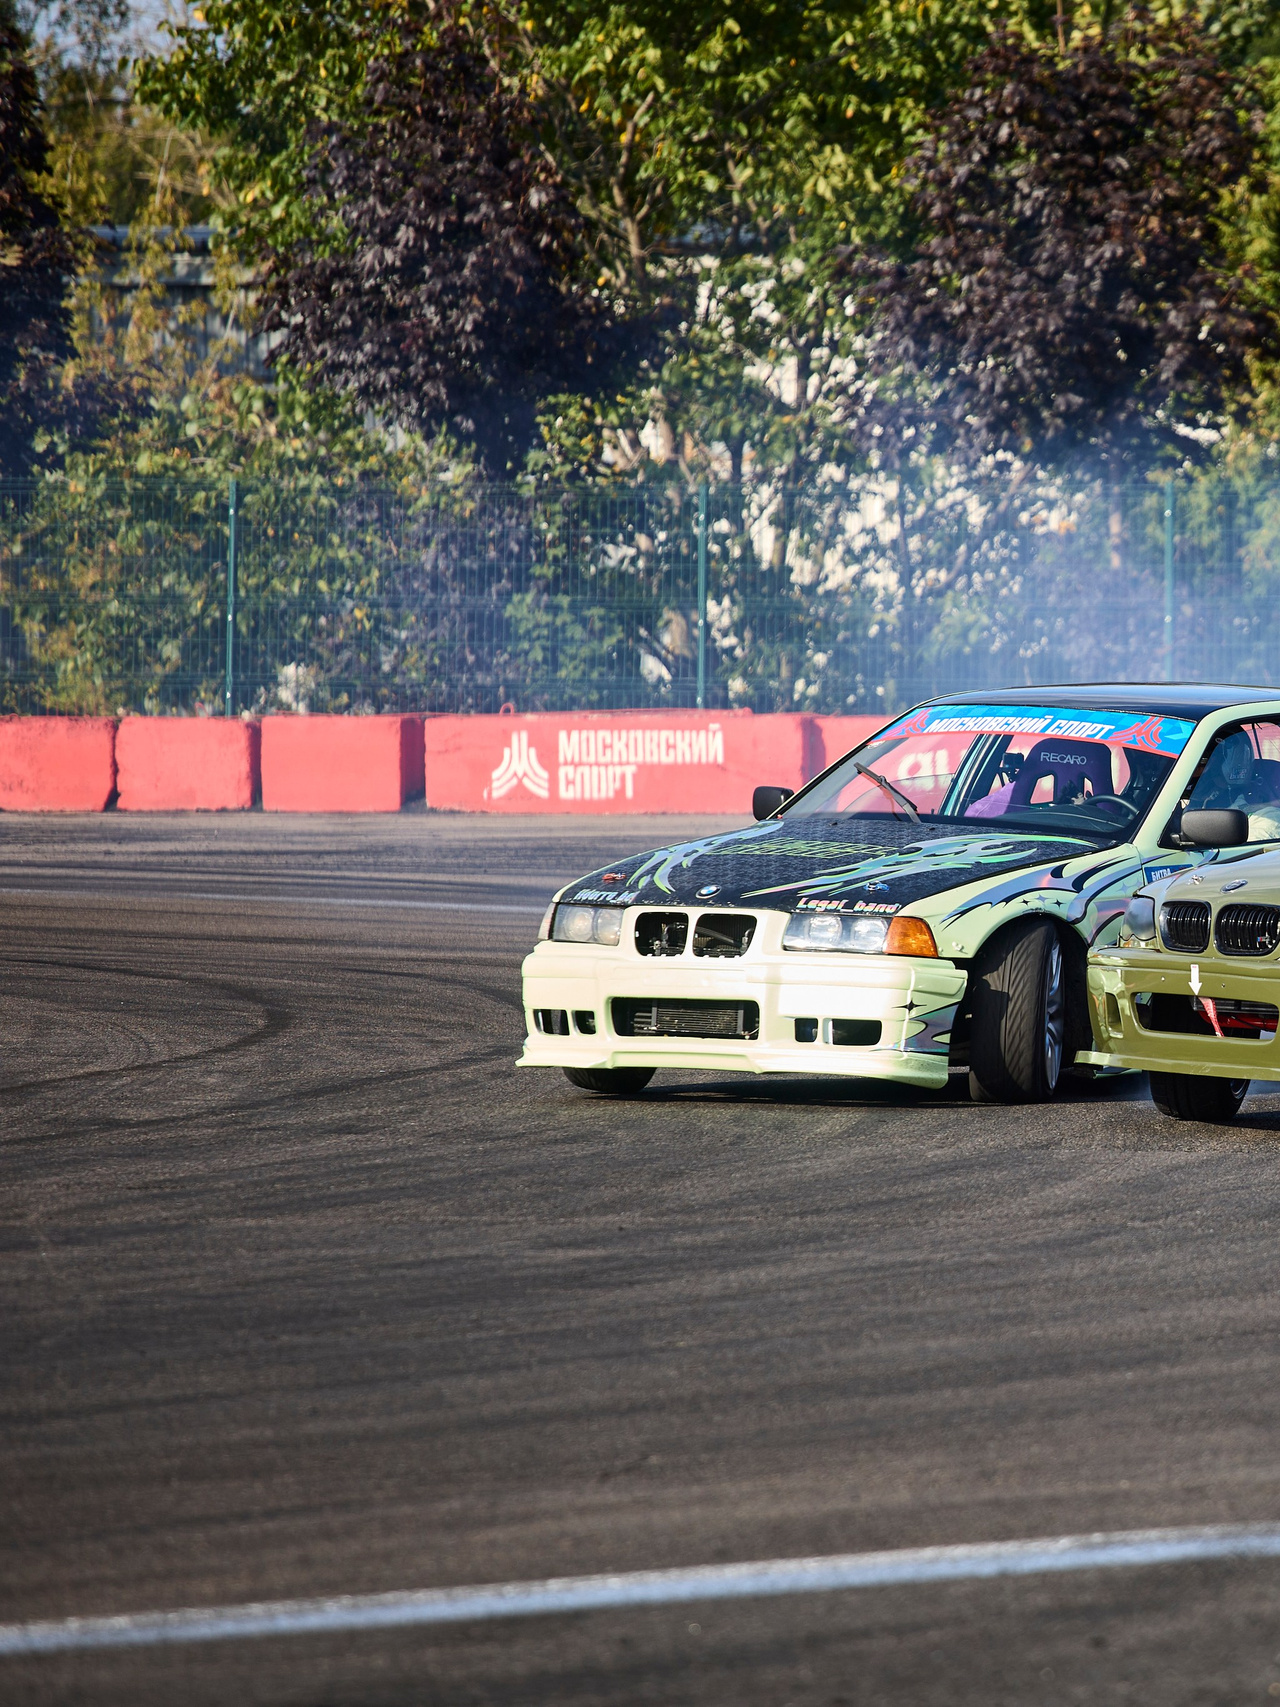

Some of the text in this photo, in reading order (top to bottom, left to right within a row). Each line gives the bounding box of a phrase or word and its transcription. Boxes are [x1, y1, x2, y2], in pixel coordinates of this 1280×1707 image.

[923, 715, 1116, 740] МОСКОВСКИЙ СПОРТ
[558, 723, 723, 765] МОСКОВСКИЙ
[1040, 751, 1087, 766] RECARO
[558, 764, 637, 800] СПОРТ
